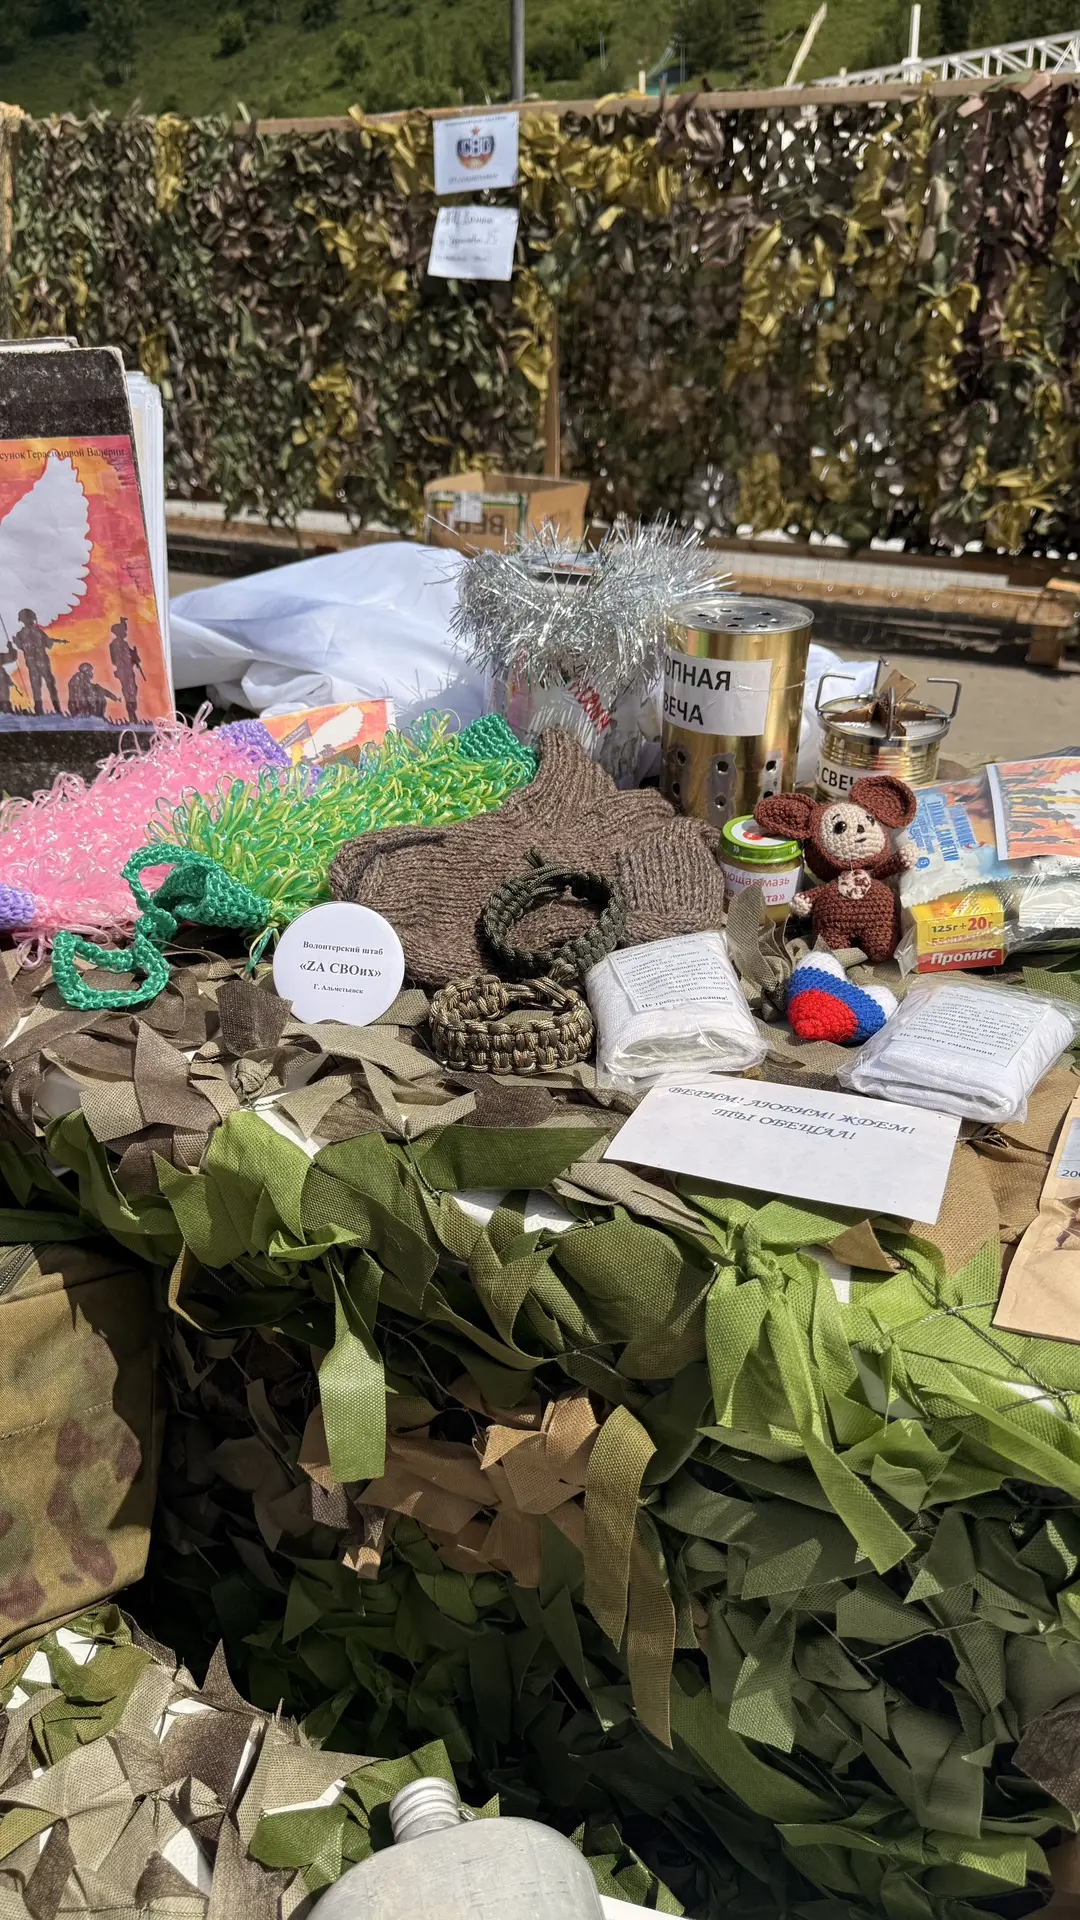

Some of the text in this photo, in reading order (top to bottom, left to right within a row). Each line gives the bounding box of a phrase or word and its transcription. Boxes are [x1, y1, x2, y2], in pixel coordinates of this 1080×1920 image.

[0, 447, 125, 460] сунок Герасимовой Валерии
[665, 656, 731, 691] ОПНАЯ
[663, 692, 703, 725] ВЕЧА
[931, 924, 958, 933] 125г
[303, 940, 384, 956] Волонтерский штаб
[930, 949, 998, 966] Промис
[329, 962, 382, 978] СВОих»
[321, 984, 364, 994] Альметьевск
[668, 1086, 917, 1135] ВЕРИМ! ЛЮБИМ! ЖДЕМ!
[711, 1107, 857, 1140] ТЫ ОБЕЩАЛ!
[1060, 1169, 1080, 1179] 20
